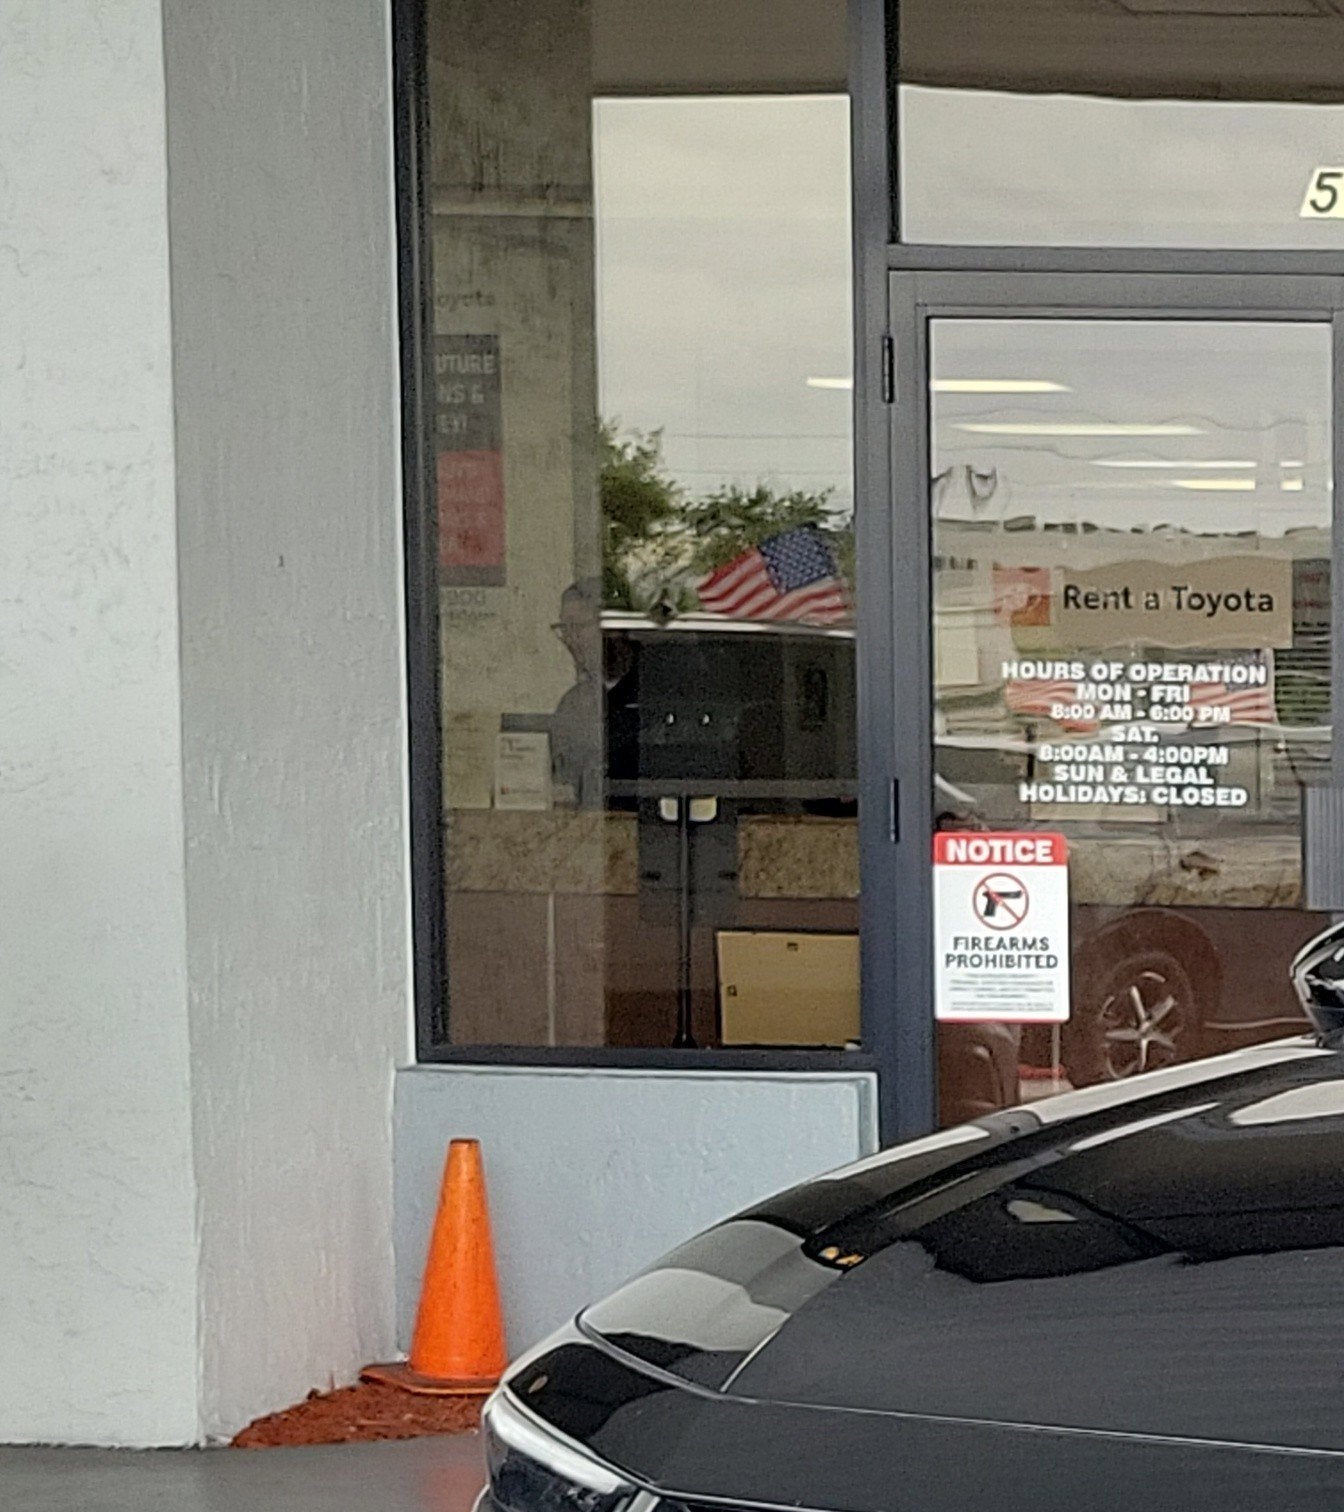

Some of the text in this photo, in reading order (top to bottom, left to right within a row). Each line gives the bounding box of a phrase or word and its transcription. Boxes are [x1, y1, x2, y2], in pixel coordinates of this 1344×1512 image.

[1063, 584, 1275, 618] Rent a Toyota
[1001, 660, 1268, 685] HOURS OF OPERATION
[1076, 682, 1133, 702] MON
[1150, 684, 1191, 704] FRI
[1050, 703, 1096, 720] 8:00
[1100, 704, 1132, 721] AM
[1149, 704, 1195, 722] 6:00
[1200, 705, 1232, 723] PM
[1111, 725, 1160, 744] SAT.
[1037, 744, 1125, 763] 8:00AM
[1142, 745, 1230, 765] 4:00PM
[1053, 764, 1215, 785] SUN & LEGAL
[1018, 783, 1249, 807] HOLIDAYS: CLOSED
[945, 837, 1054, 864] NOTICE
[952, 935, 1050, 952] FIREARMS
[944, 953, 1059, 969] PROHIBITED
